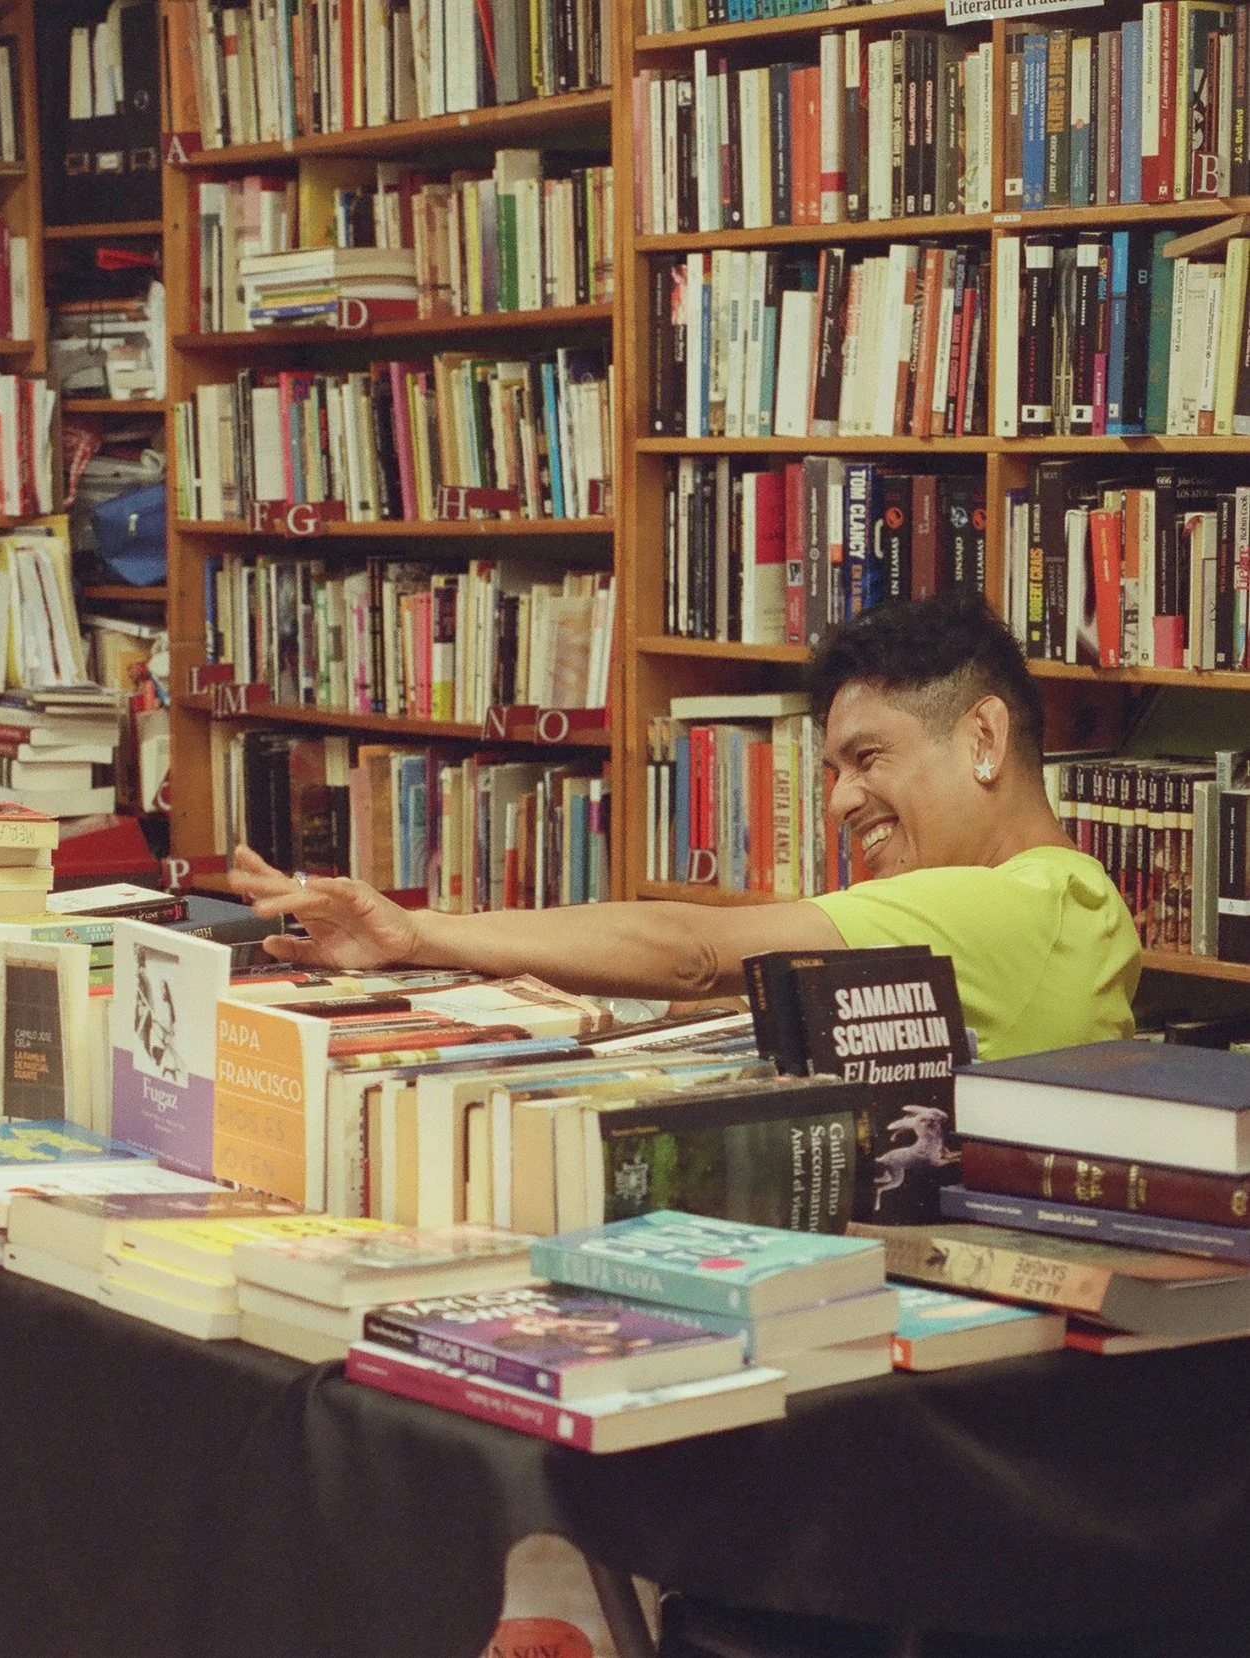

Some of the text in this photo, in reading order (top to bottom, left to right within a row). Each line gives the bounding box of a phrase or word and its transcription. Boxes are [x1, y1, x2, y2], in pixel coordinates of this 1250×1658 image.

[950, 0, 1023, 16] Literatura
[1163, 40, 1169, 48] la
[1163, 49, 1169, 59] de
[1161, 99, 1168, 109] La
[166, 135, 189, 165] A
[1198, 154, 1218, 194] B
[338, 298, 368, 331] D
[254, 502, 270, 532] F
[287, 503, 317, 535] G
[441, 487, 469, 520] H
[848, 469, 866, 560] TOM CLANCY
[1240, 494, 1248, 541] Robin Cook
[891, 537, 899, 596] EN LLAMAS
[976, 538, 984, 580] LLAMAS
[1029, 549, 1043, 622] ROBERT CRAIS
[191, 667, 208, 695] L
[222, 684, 248, 714] M
[487, 707, 508, 741] N
[539, 710, 569, 742] O
[775, 769, 791, 865] CARTA BLANCA
[168, 858, 190, 889] P
[689, 849, 717, 883] D
[835, 982, 937, 1021] SAMANTA
[14, 1038, 31, 1048] CELA
[15, 1029, 38, 1041] CAMILO
[218, 1019, 261, 1051] PAPA
[833, 1017, 950, 1057] SCHWEBLIN
[218, 1059, 303, 1104] FRANCISCO
[844, 1053, 952, 1084] El buen mal
[143, 1076, 179, 1113] Fugaz
[791, 1127, 804, 1233] Arderá el vien
[829, 1121, 846, 1216] Guillermo
[613, 1264, 662, 1294] TUYA
[416, 1332, 461, 1365] TAYLOR
[463, 1346, 498, 1374] SWIFT
